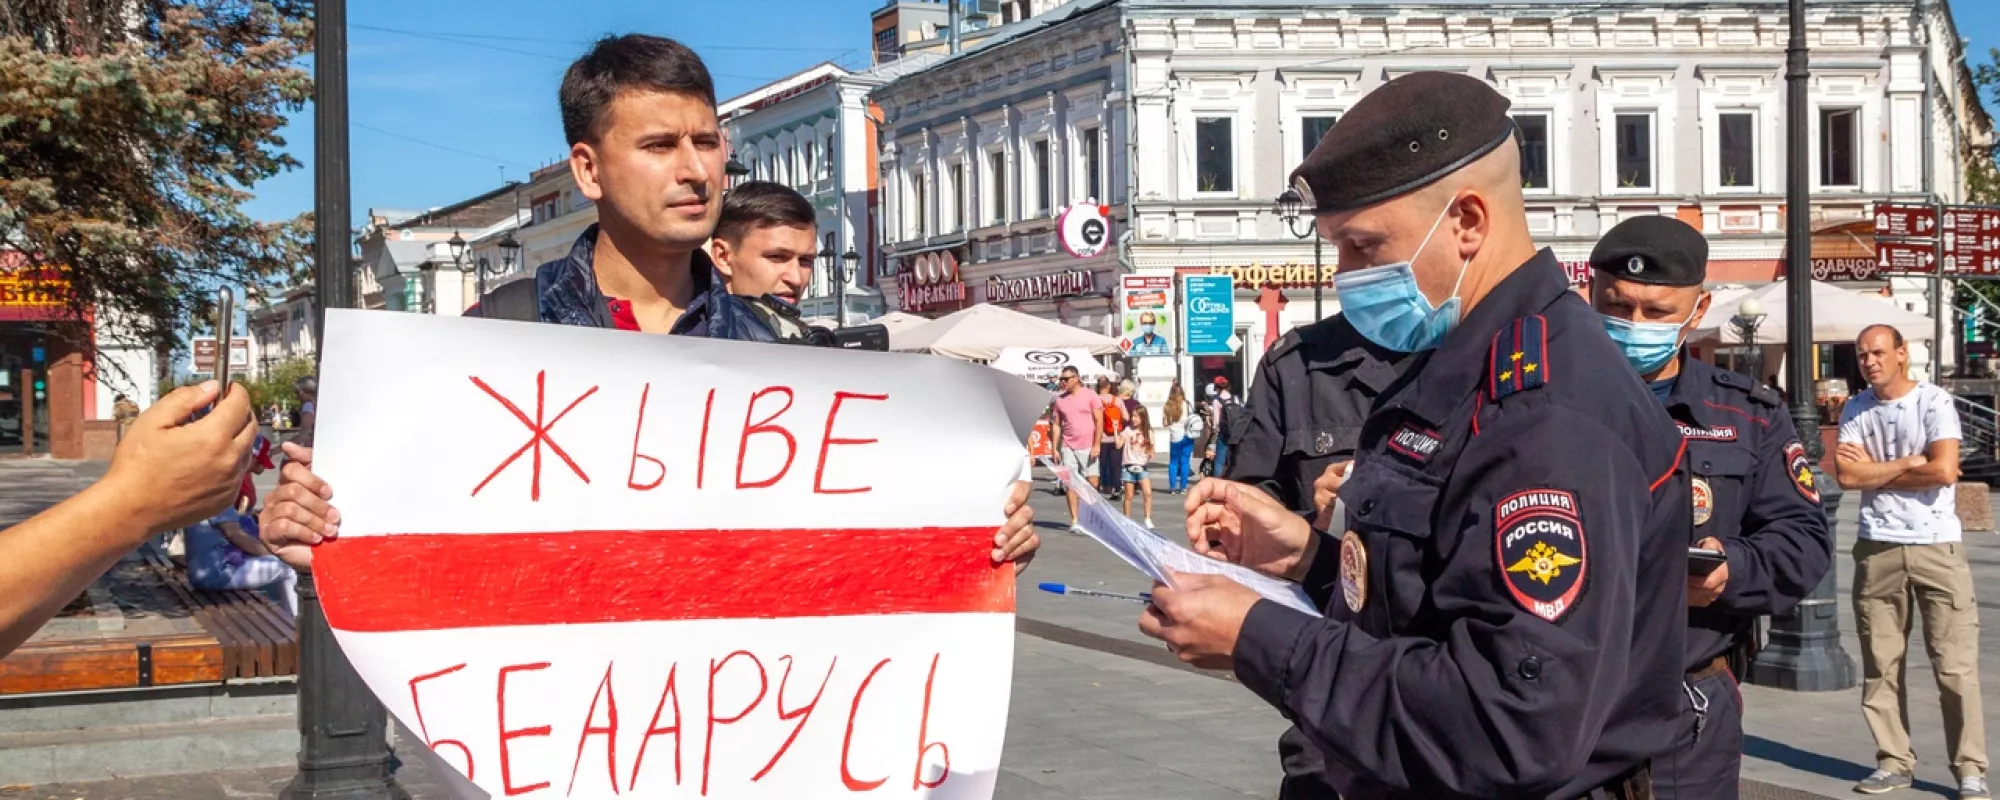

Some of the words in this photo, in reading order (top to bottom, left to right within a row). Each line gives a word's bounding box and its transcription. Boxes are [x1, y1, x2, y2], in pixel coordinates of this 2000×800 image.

[1811, 258, 1876, 280] ЗАВЧЕР
[469, 370, 890, 502] ЖЫВЕ
[1501, 493, 1571, 518] ПОЛИЦИЯ
[1505, 520, 1574, 548] РОССИЯ
[1533, 598, 1565, 620] МВД
